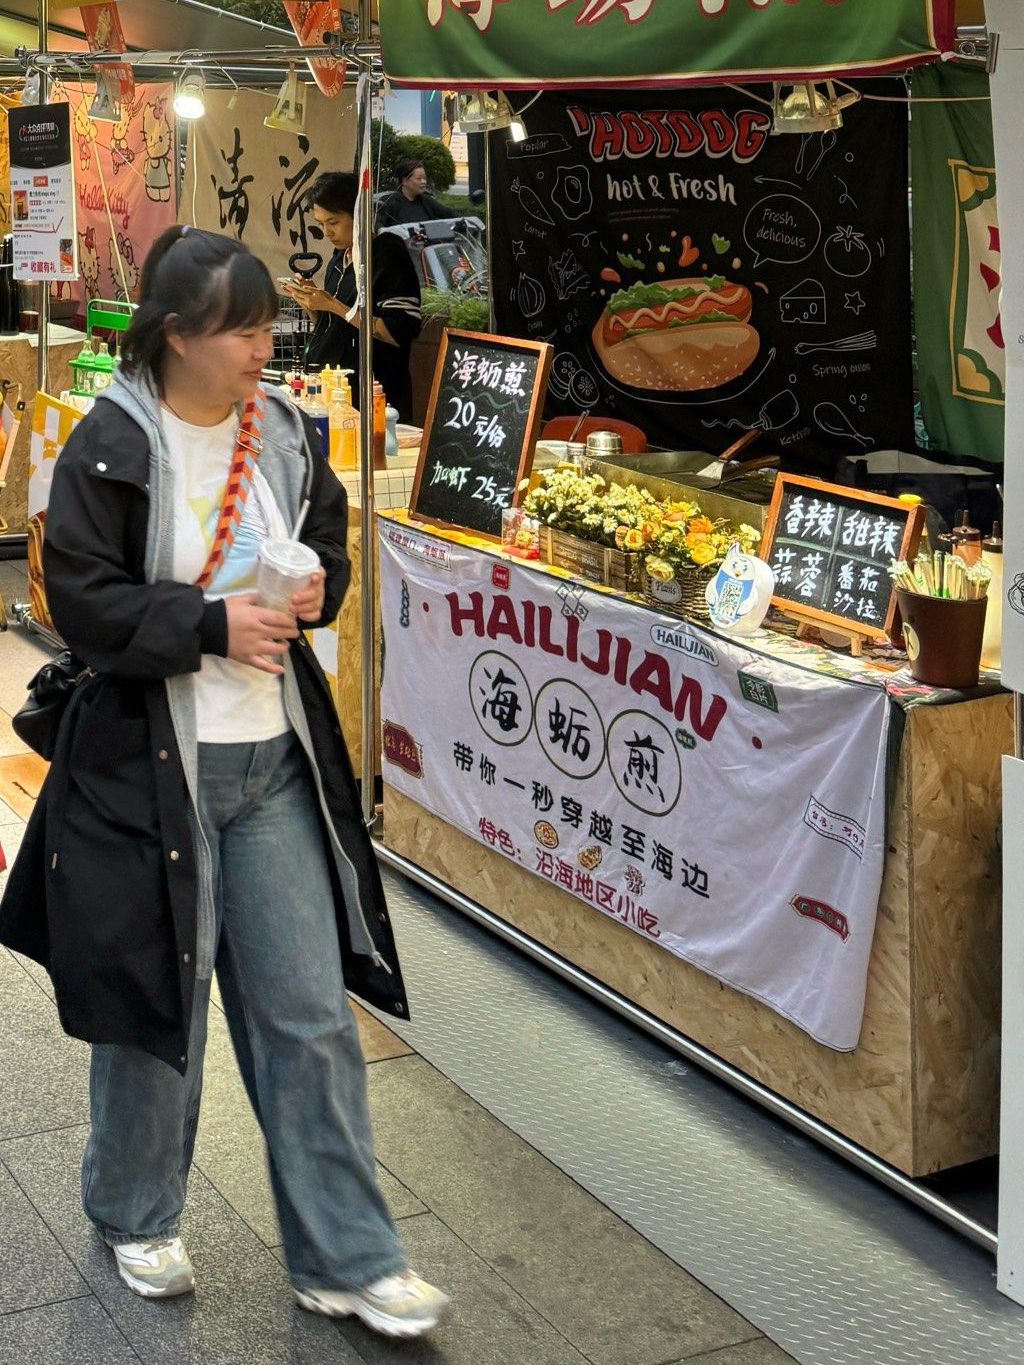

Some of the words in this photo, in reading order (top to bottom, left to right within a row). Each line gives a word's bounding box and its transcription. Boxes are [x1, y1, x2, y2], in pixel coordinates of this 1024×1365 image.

[651, 177, 665, 199] &
[667, 172, 738, 207] Fresh
[763, 208, 798, 228] Fresh,
[756, 228, 807, 249] delicious
[812, 363, 848, 378] Spring
[785, 495, 836, 538] 香辣
[842, 510, 902, 558] 甜辣
[837, 560, 881, 592] 番茄
[833, 591, 878, 620] 沙拉
[445, 591, 728, 741] HAILIJIAN
[479, 667, 666, 804] 海蛎煎
[453, 741, 711, 899] 带你一秒穿越至海边
